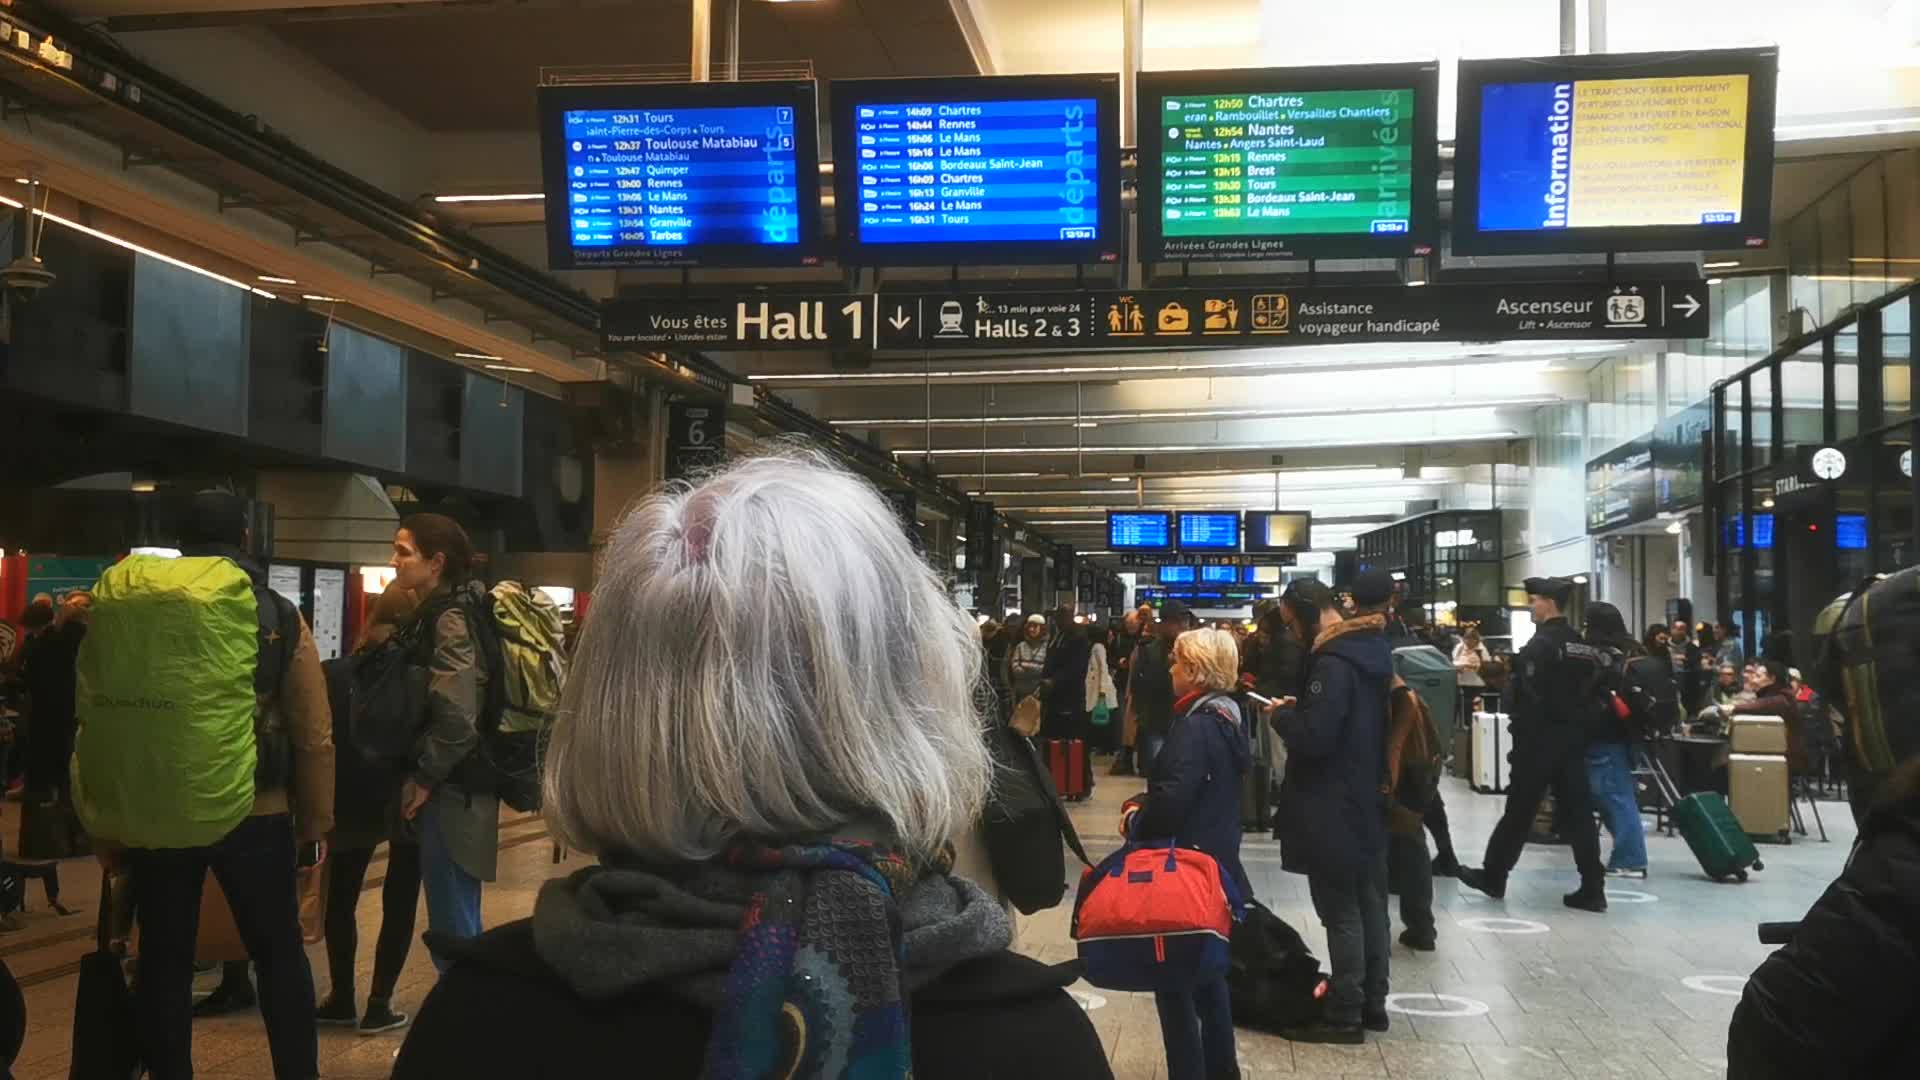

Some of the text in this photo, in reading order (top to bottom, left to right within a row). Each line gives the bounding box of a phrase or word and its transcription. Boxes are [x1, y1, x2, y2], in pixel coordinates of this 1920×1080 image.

[1213, 98, 1244, 109] 12h50
[1248, 95, 1304, 108] Chartres
[643, 111, 674, 123] Tours
[782, 110, 789, 120] 7
[905, 106, 933, 117] 14h09
[938, 105, 982, 116] Chartres
[1215, 110, 1279, 121] Rambouillet
[1287, 108, 1337, 120] Versailles
[1339, 106, 1391, 118] Chantiers
[699, 123, 725, 134] Tours
[939, 118, 977, 129] Rennes
[1213, 126, 1244, 137] 12h54
[1248, 123, 1294, 136] Nantes
[614, 136, 758, 151] 12h37 Toulouse Matabiau
[783, 137, 790, 147] 5
[939, 133, 952, 143] Le
[953, 132, 982, 143] Mans
[1185, 136, 1325, 150] Nantes Angers Saint-Laud
[601, 152, 642, 162] Toulouse
[645, 151, 690, 162] Matabiau
[939, 147, 952, 157] Le
[954, 146, 982, 157] Mans
[1247, 151, 1287, 162] Rennes
[1371, 90, 1399, 217] arrivées
[1543, 83, 1571, 227] Information
[646, 164, 689, 176] Quimper
[940, 159, 987, 171] Bordeaux
[989, 158, 1044, 170] Saint-Jean
[1059, 105, 1091, 225] départs
[1247, 165, 1276, 176] Brest
[647, 177, 684, 189] Rennes
[762, 126, 793, 242] départs
[940, 173, 984, 184] Chartres
[1247, 179, 1277, 190] Tours
[648, 191, 660, 202] Le
[661, 190, 689, 202] Mans
[941, 186, 986, 198] Granville
[1247, 192, 1296, 204] Bordeaux
[1298, 191, 1356, 203] Saint-Jean
[648, 204, 684, 215] Nantes
[941, 200, 954, 211] Le
[955, 200, 983, 211] Mans
[1247, 206, 1260, 217] Le
[1262, 205, 1290, 217] Mans
[649, 217, 693, 228] Granville
[942, 213, 970, 225] Tours
[650, 230, 683, 241] Tarbes
[1164, 239, 1284, 250] Arrivées Grandes Lignes
[1118, 295, 1134, 304] WC
[998, 302, 1081, 316] 13 min par voie 24
[1298, 302, 1374, 315] Assistance
[1496, 298, 1594, 315] Ascenseur
[650, 314, 728, 329] Vous êtes
[736, 300, 863, 340] Hall 1
[1518, 318, 1593, 330] Lift Ascensor
[974, 317, 1081, 339] Halls 2 & 3
[1299, 317, 1441, 337] voyageur handicapé
[688, 420, 705, 445] 6
